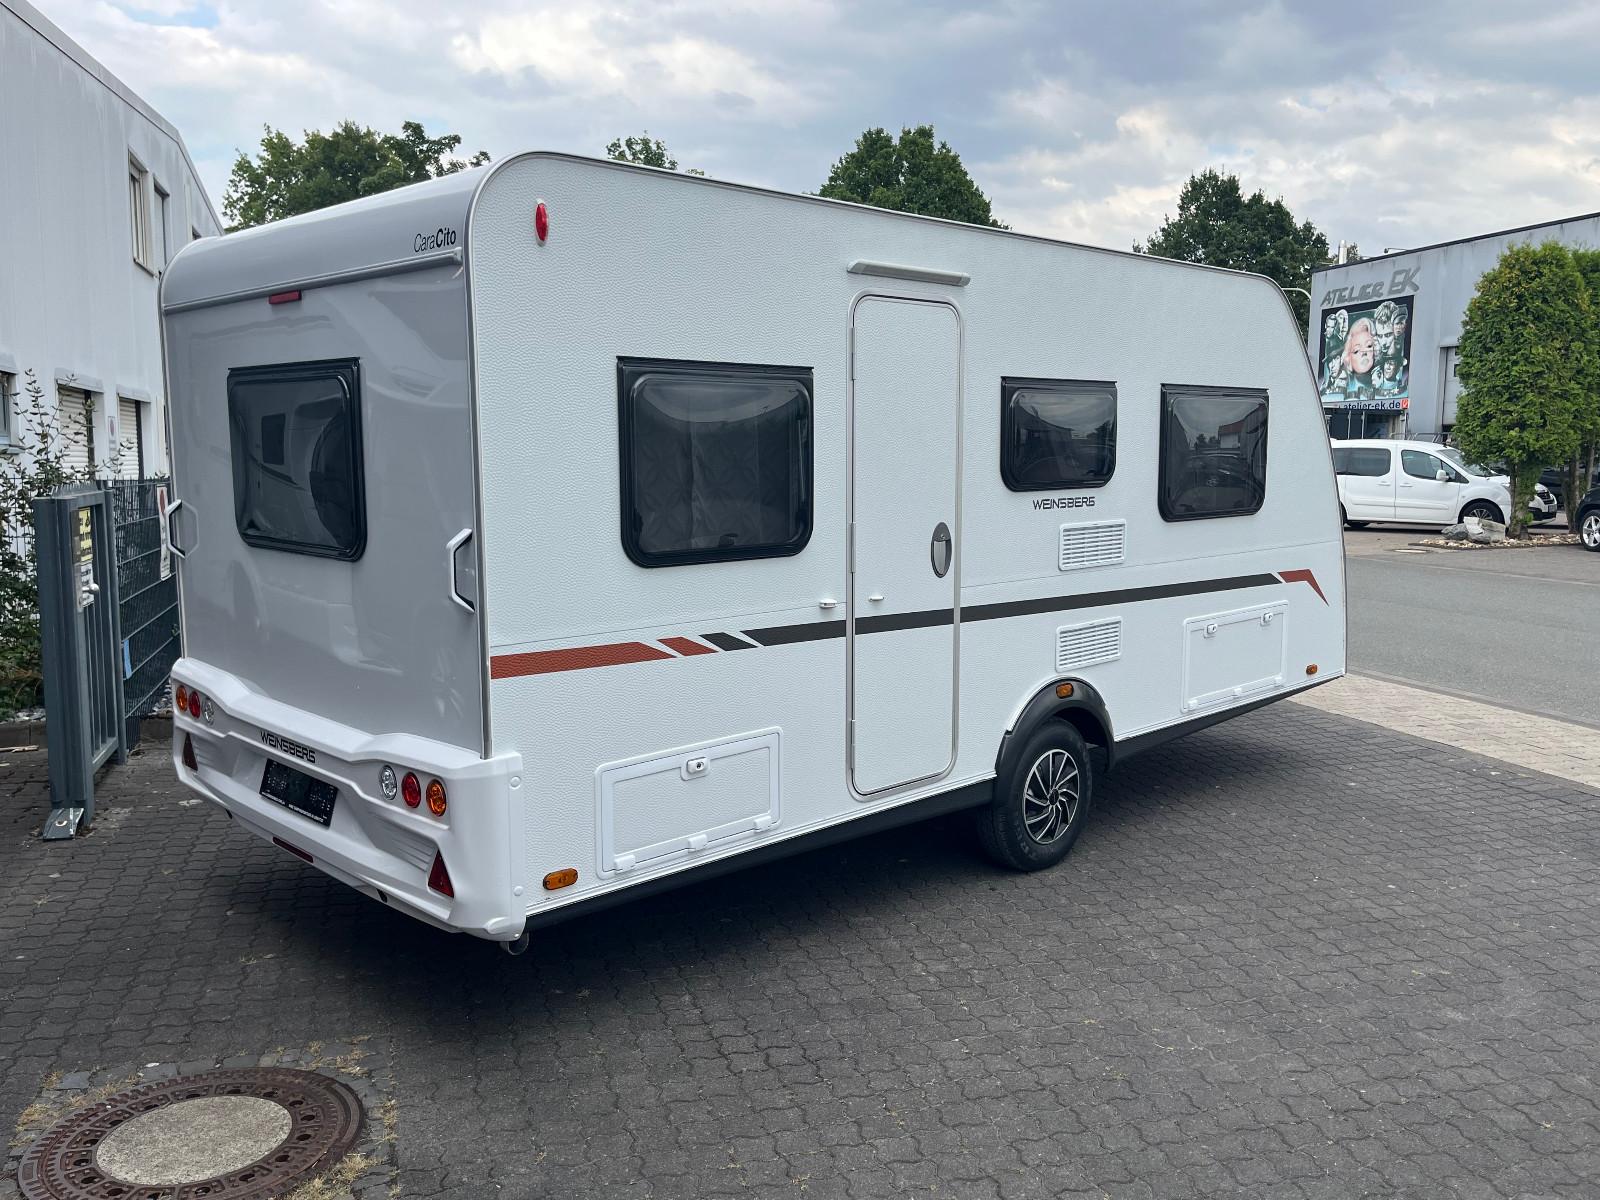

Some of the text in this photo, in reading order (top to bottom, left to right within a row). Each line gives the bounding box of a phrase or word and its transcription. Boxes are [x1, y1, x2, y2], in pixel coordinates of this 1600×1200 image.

[414, 227, 456, 252] CaraCito
[1320, 266, 1421, 307] ATELIER EK
[1033, 496, 1095, 510] WEINSBERG
[260, 731, 316, 763] WEINSBERG
